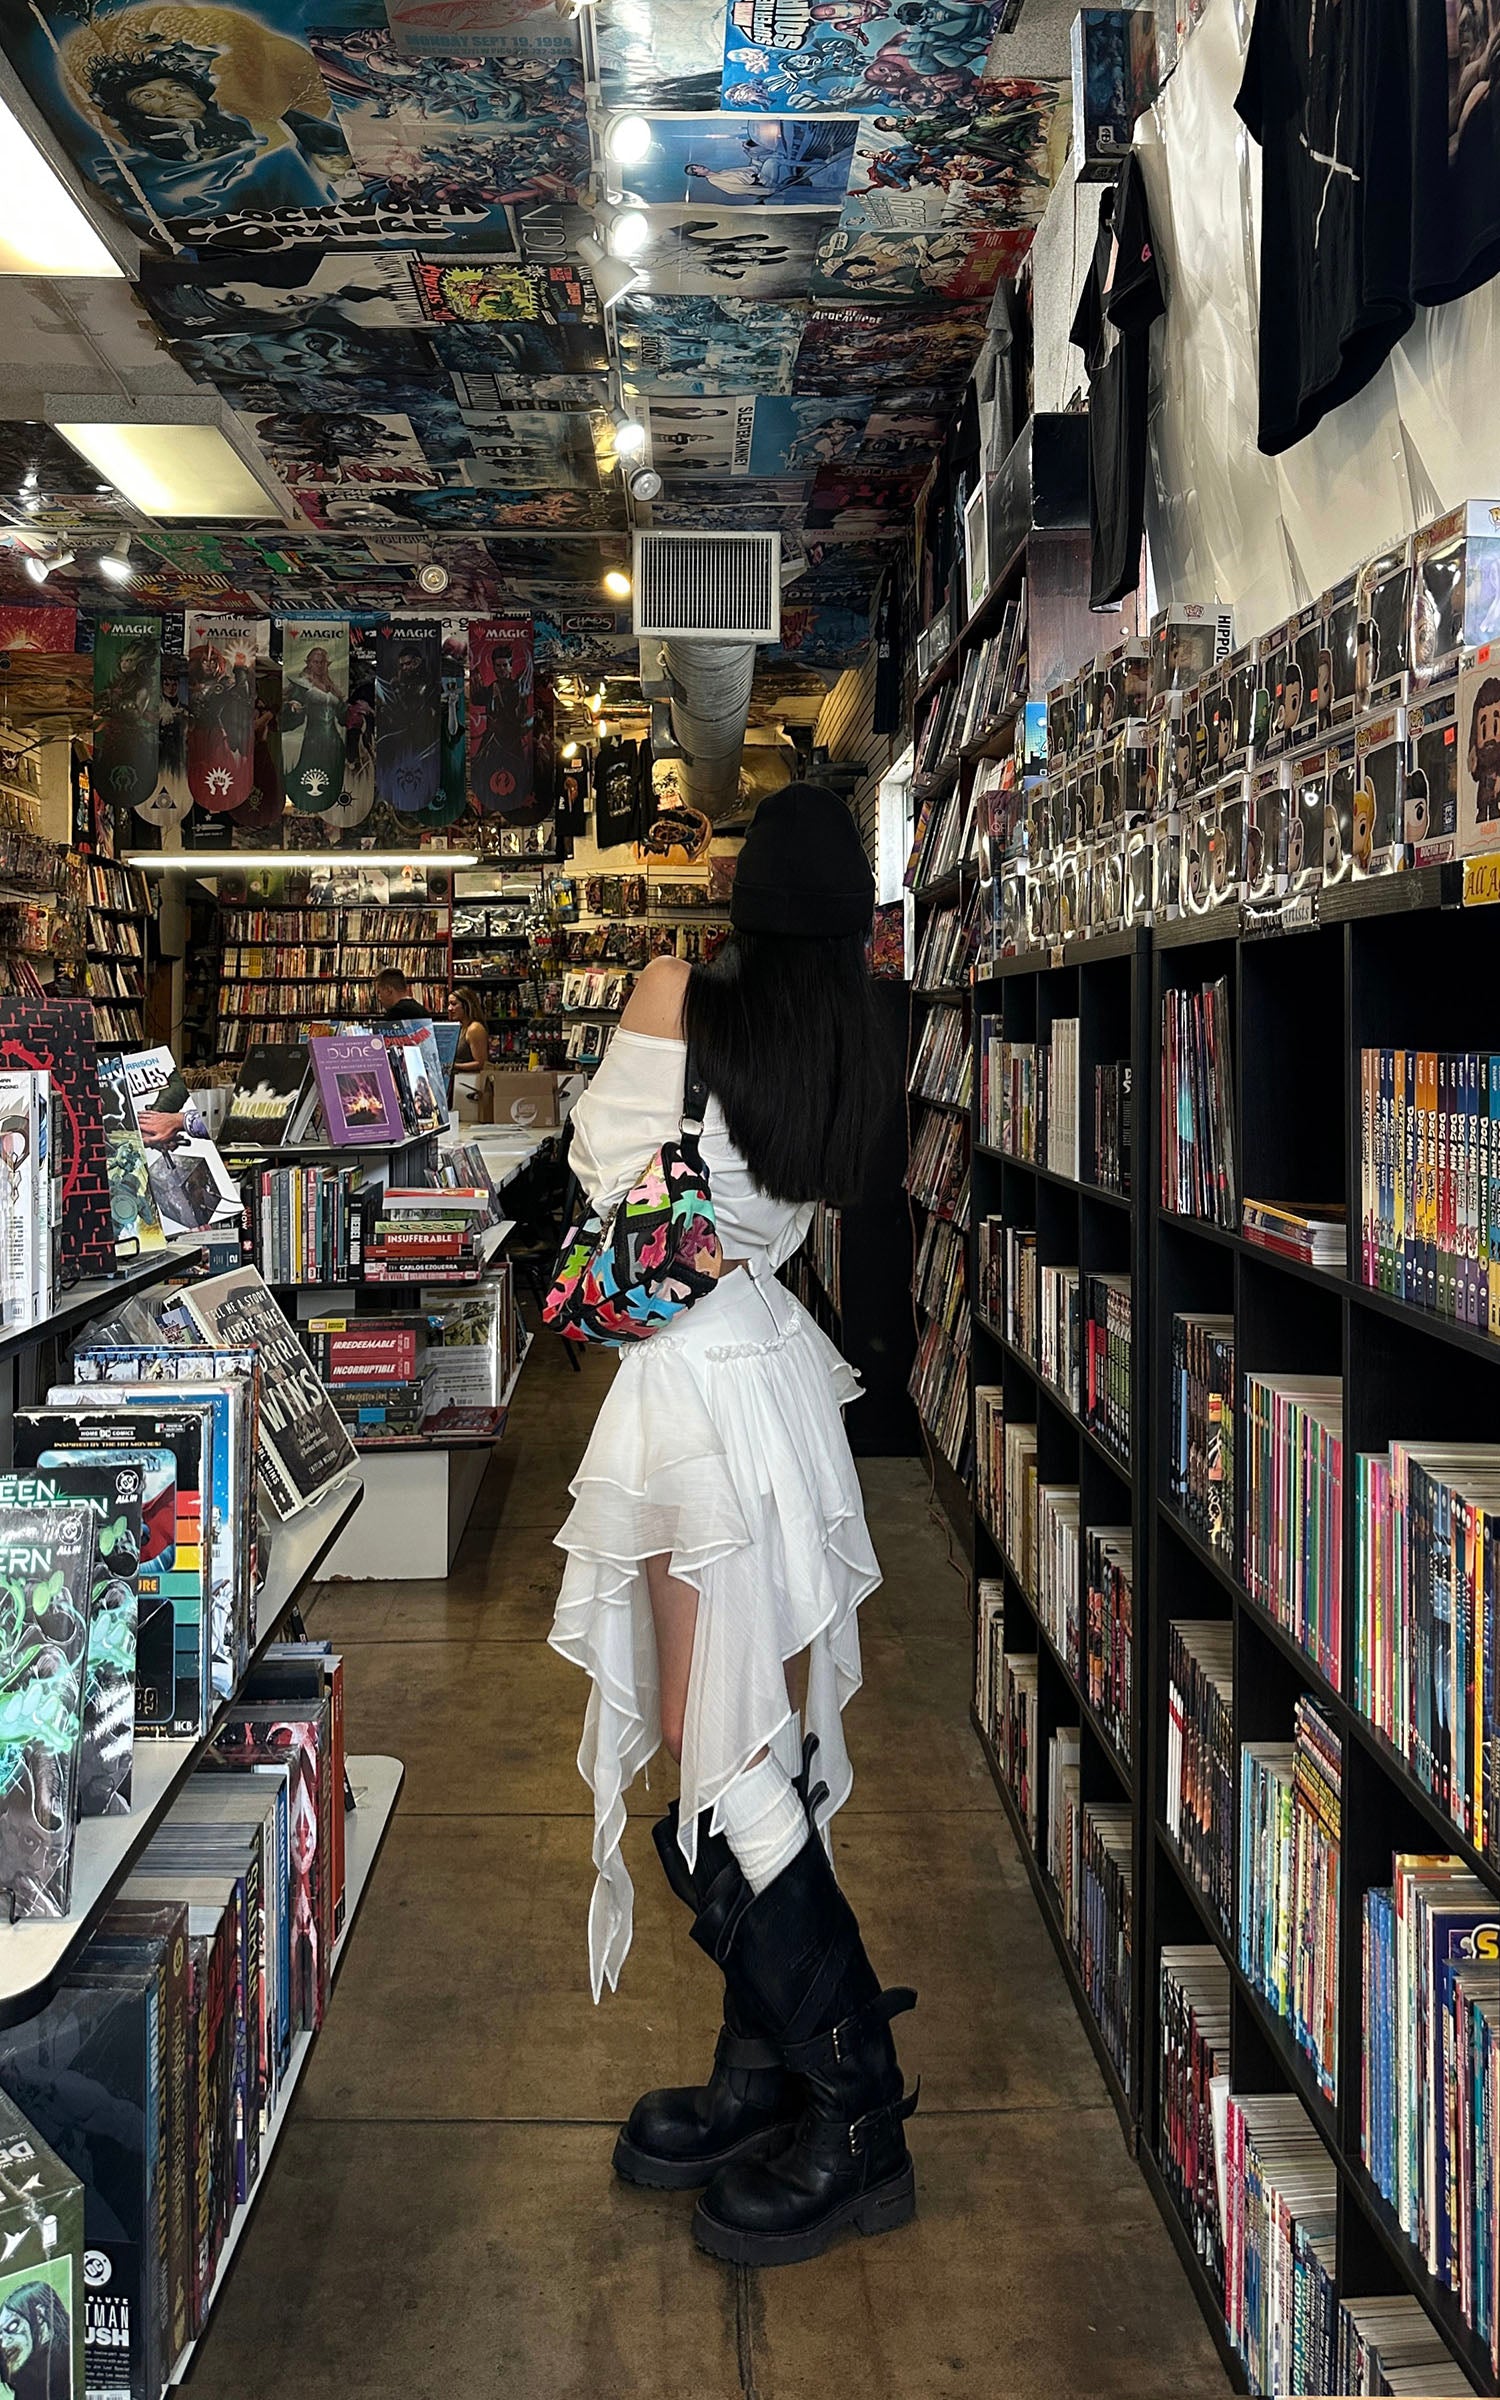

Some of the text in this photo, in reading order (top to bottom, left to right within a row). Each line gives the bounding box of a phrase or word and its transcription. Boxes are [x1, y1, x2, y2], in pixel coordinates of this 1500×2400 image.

[405, 35, 468, 47] MONDAY
[472, 35, 507, 47] SEPT
[536, 36, 573, 48] 1994
[208, 219, 457, 252] ORANGE
[418, 262, 444, 305] STRANGE
[734, 406, 753, 467] SLEATER-KINNEY
[111, 624, 156, 634] MAGIC
[206, 628, 250, 637] MAGIC
[300, 630, 344, 639] MAGIC
[393, 629, 437, 639] MAGIC
[485, 629, 529, 639] MAGIC
[566, 615, 612, 631] CHAOS
[327, 1046, 374, 1059] DUNE
[1406, 1106, 1414, 1159] DOG MAN
[1416, 1109, 1425, 1164] DOG MAN
[1427, 1111, 1436, 1165] DOG MAN
[1438, 1112, 1446, 1168] DOG MAN
[1449, 1114, 1458, 1170] DOG MAN
[1457, 1114, 1466, 1170] DOG MAN
[1469, 1114, 1477, 1173] DOG MAN
[1479, 1117, 1488, 1145] DOG
[1479, 1149, 1488, 1175] MAN
[350, 1216, 361, 1265] REBEL MOON
[388, 1234, 452, 1243] INSUFFERABLE
[205, 1289, 268, 1319] TELL ME A STORY
[219, 1308, 282, 1346] WHERE THE
[333, 1339, 397, 1350] IRREDEEMABLE
[333, 1364, 396, 1375] INCORRUPTIBLE
[259, 1368, 323, 1434] WINS
[264, 1460, 280, 1485] WINS
[1464, 1580, 1472, 1644] AMULET
[277, 1801, 289, 1924] NIGHTWING
[245, 1860, 260, 1998] STARMAN
[148, 1992, 159, 2092] BATMAN
[195, 2004, 209, 2233] SUICIDE SQUAD
[84, 2303, 129, 2329] TMAN
[88, 2296, 129, 2305] OLUTE
[1294, 2269, 1302, 2344] GOTHAM
[84, 2327, 129, 2347] USH
